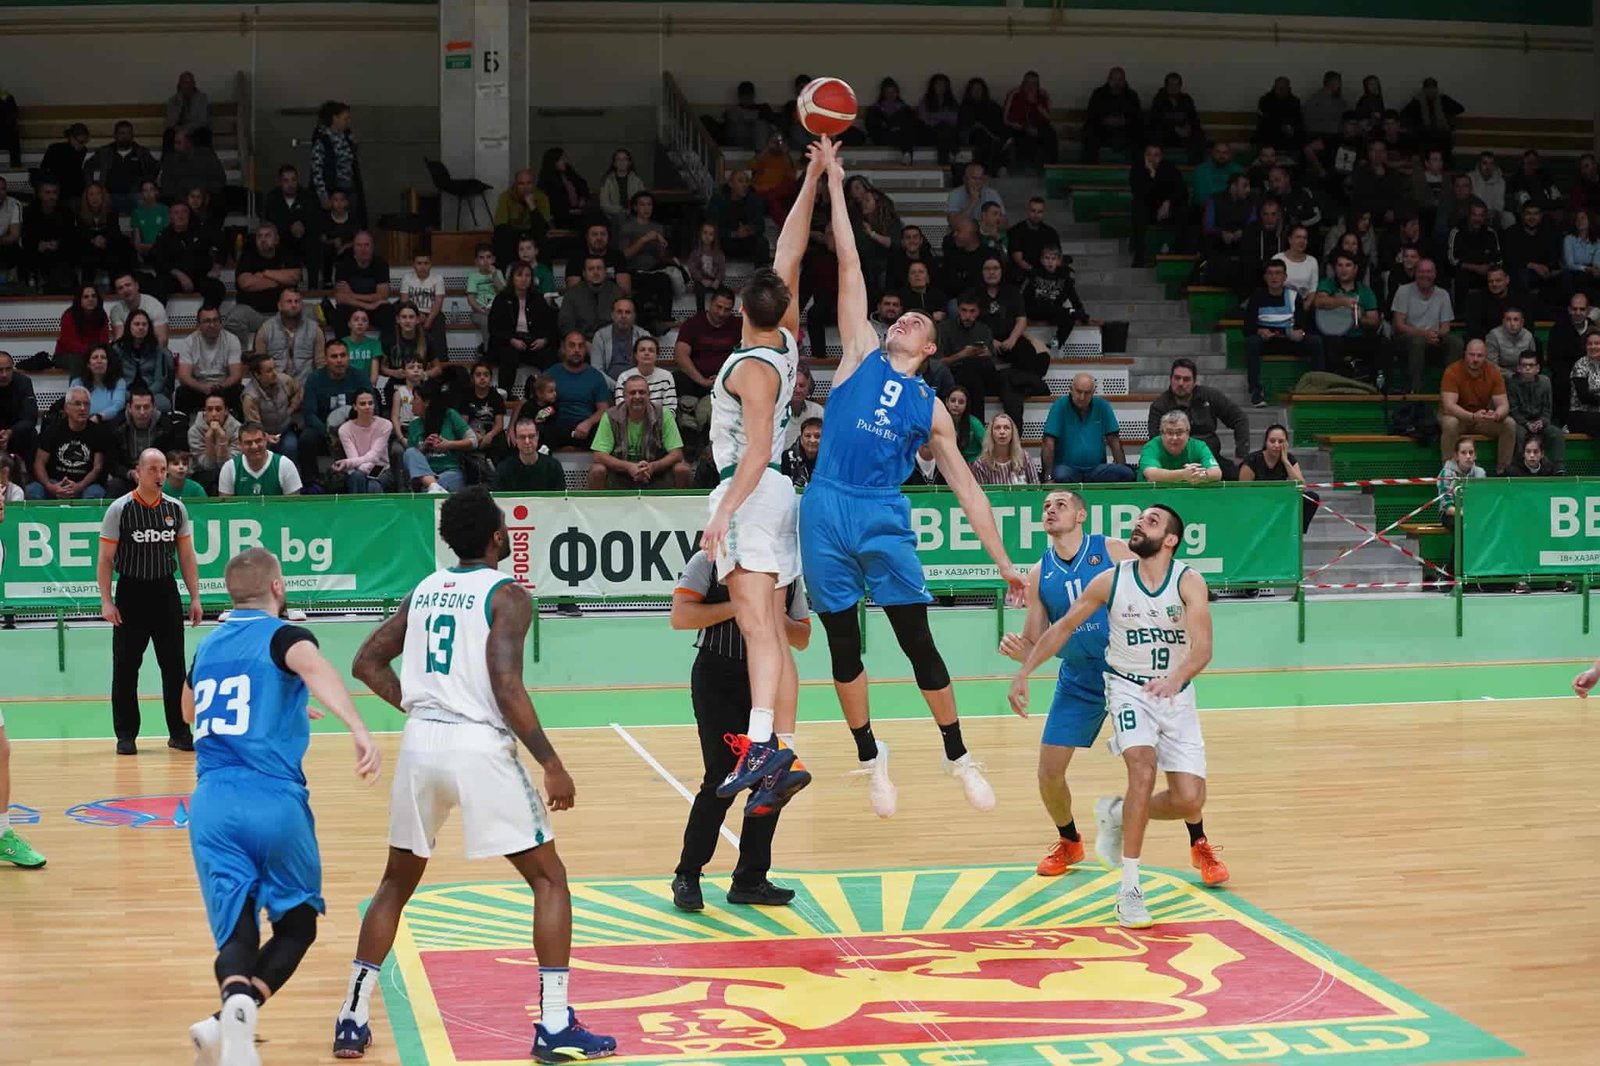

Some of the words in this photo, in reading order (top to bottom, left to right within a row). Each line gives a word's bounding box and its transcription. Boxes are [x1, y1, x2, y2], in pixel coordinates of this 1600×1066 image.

[880, 379, 903, 408] 9
[856, 418, 883, 436] PALMS
[131, 528, 176, 543] efbet
[549, 526, 705, 587] ФОКУ
[929, 568, 942, 576] 18+
[42, 586, 57, 594] 18+
[414, 592, 476, 610] PARSONS
[1064, 578, 1083, 606] 11
[425, 613, 456, 676] 13
[1125, 628, 1186, 646] BEROE
[1150, 647, 1170, 670] 19
[192, 674, 251, 744] 23
[1117, 709, 1137, 732] 19
